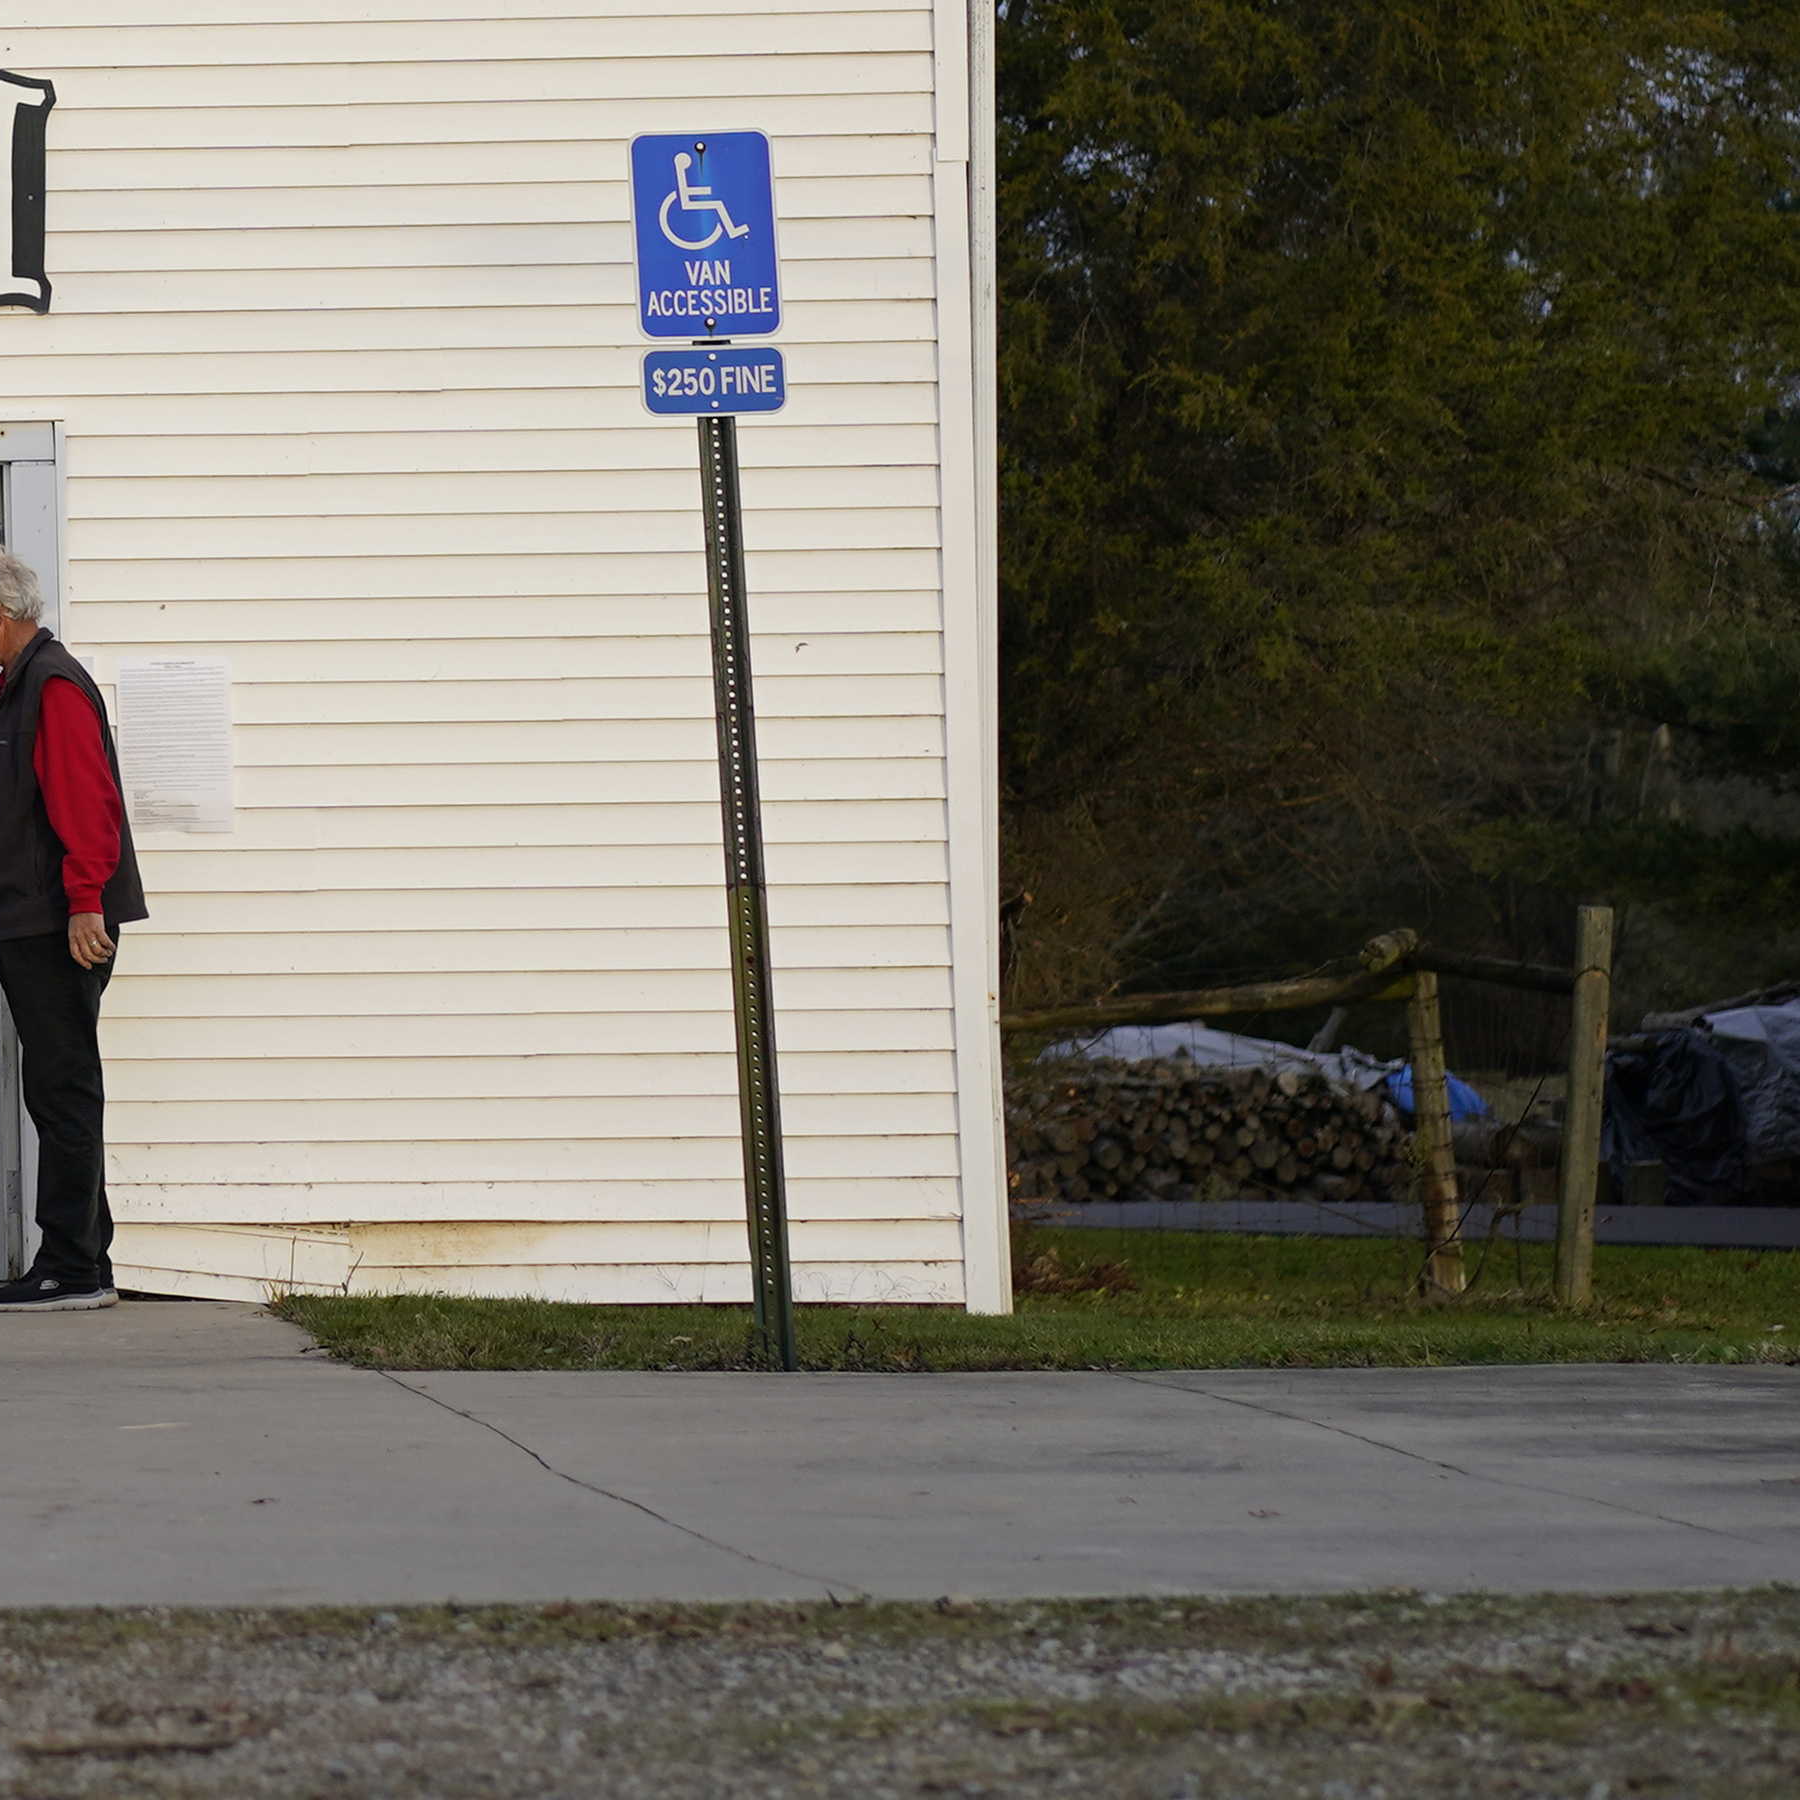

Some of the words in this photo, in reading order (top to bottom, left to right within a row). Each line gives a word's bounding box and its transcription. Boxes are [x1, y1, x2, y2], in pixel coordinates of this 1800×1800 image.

[684, 260, 731, 286] VAN
[647, 287, 774, 317] ACCESSIBLE
[652, 367, 716, 397] $250
[720, 364, 777, 395] FINE
